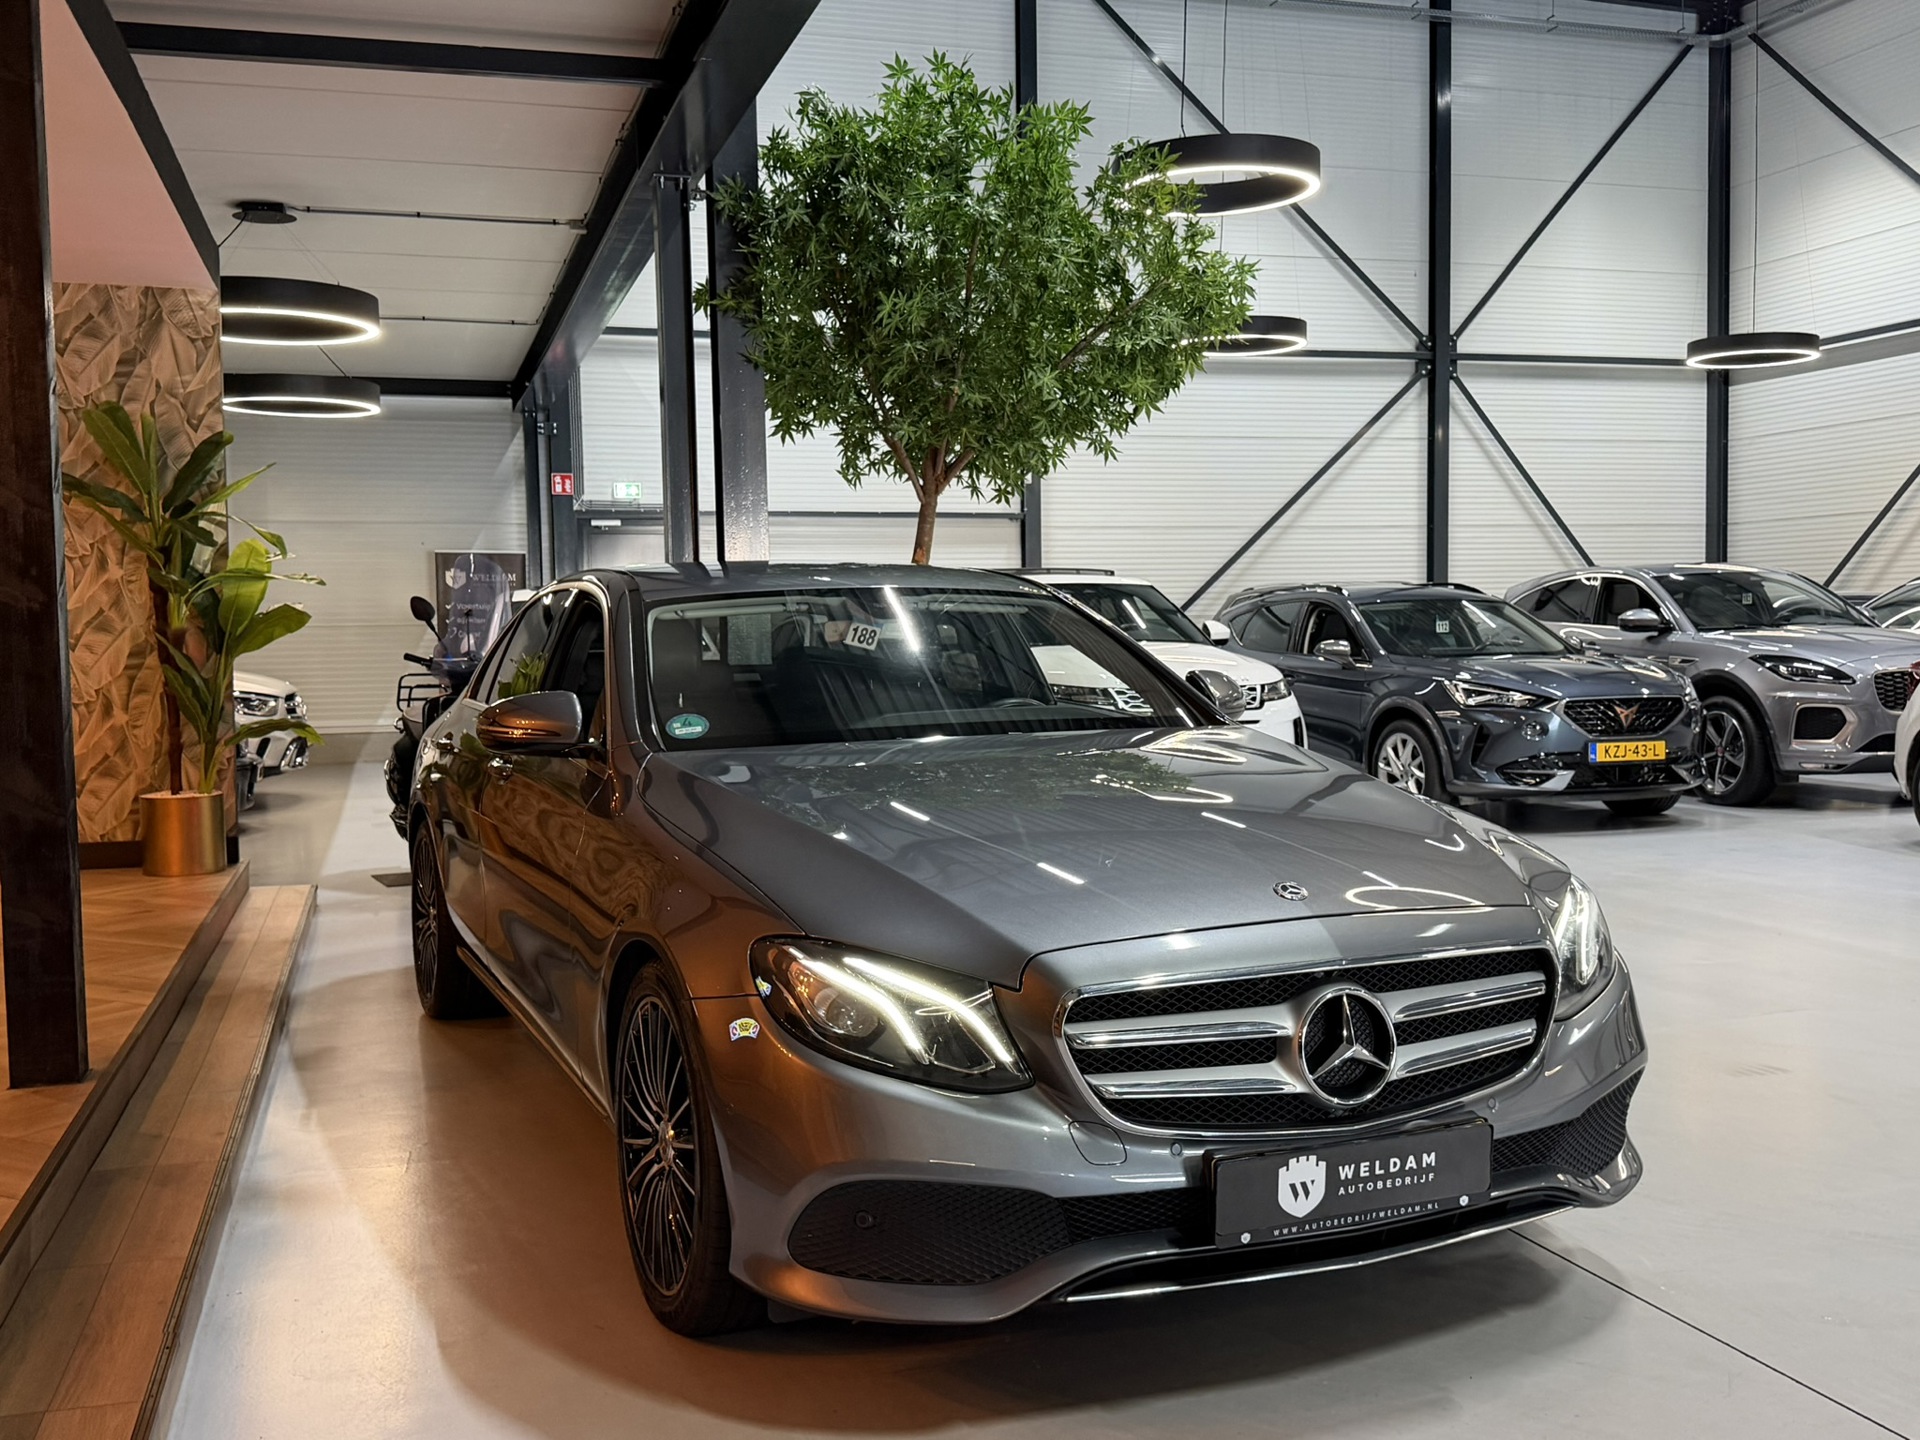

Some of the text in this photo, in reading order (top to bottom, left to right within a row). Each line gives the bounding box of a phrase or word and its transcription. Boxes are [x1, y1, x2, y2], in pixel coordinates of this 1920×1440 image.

[851, 625, 877, 647] 188
[1604, 743, 1660, 759] KZJ-43-L
[1338, 1151, 1436, 1181] WELDAM
[1338, 1172, 1435, 1196] AUTOBEDRIJF
[1273, 1202, 1439, 1237] WWW.AUTOBEDRIJFWELDAM.NL
